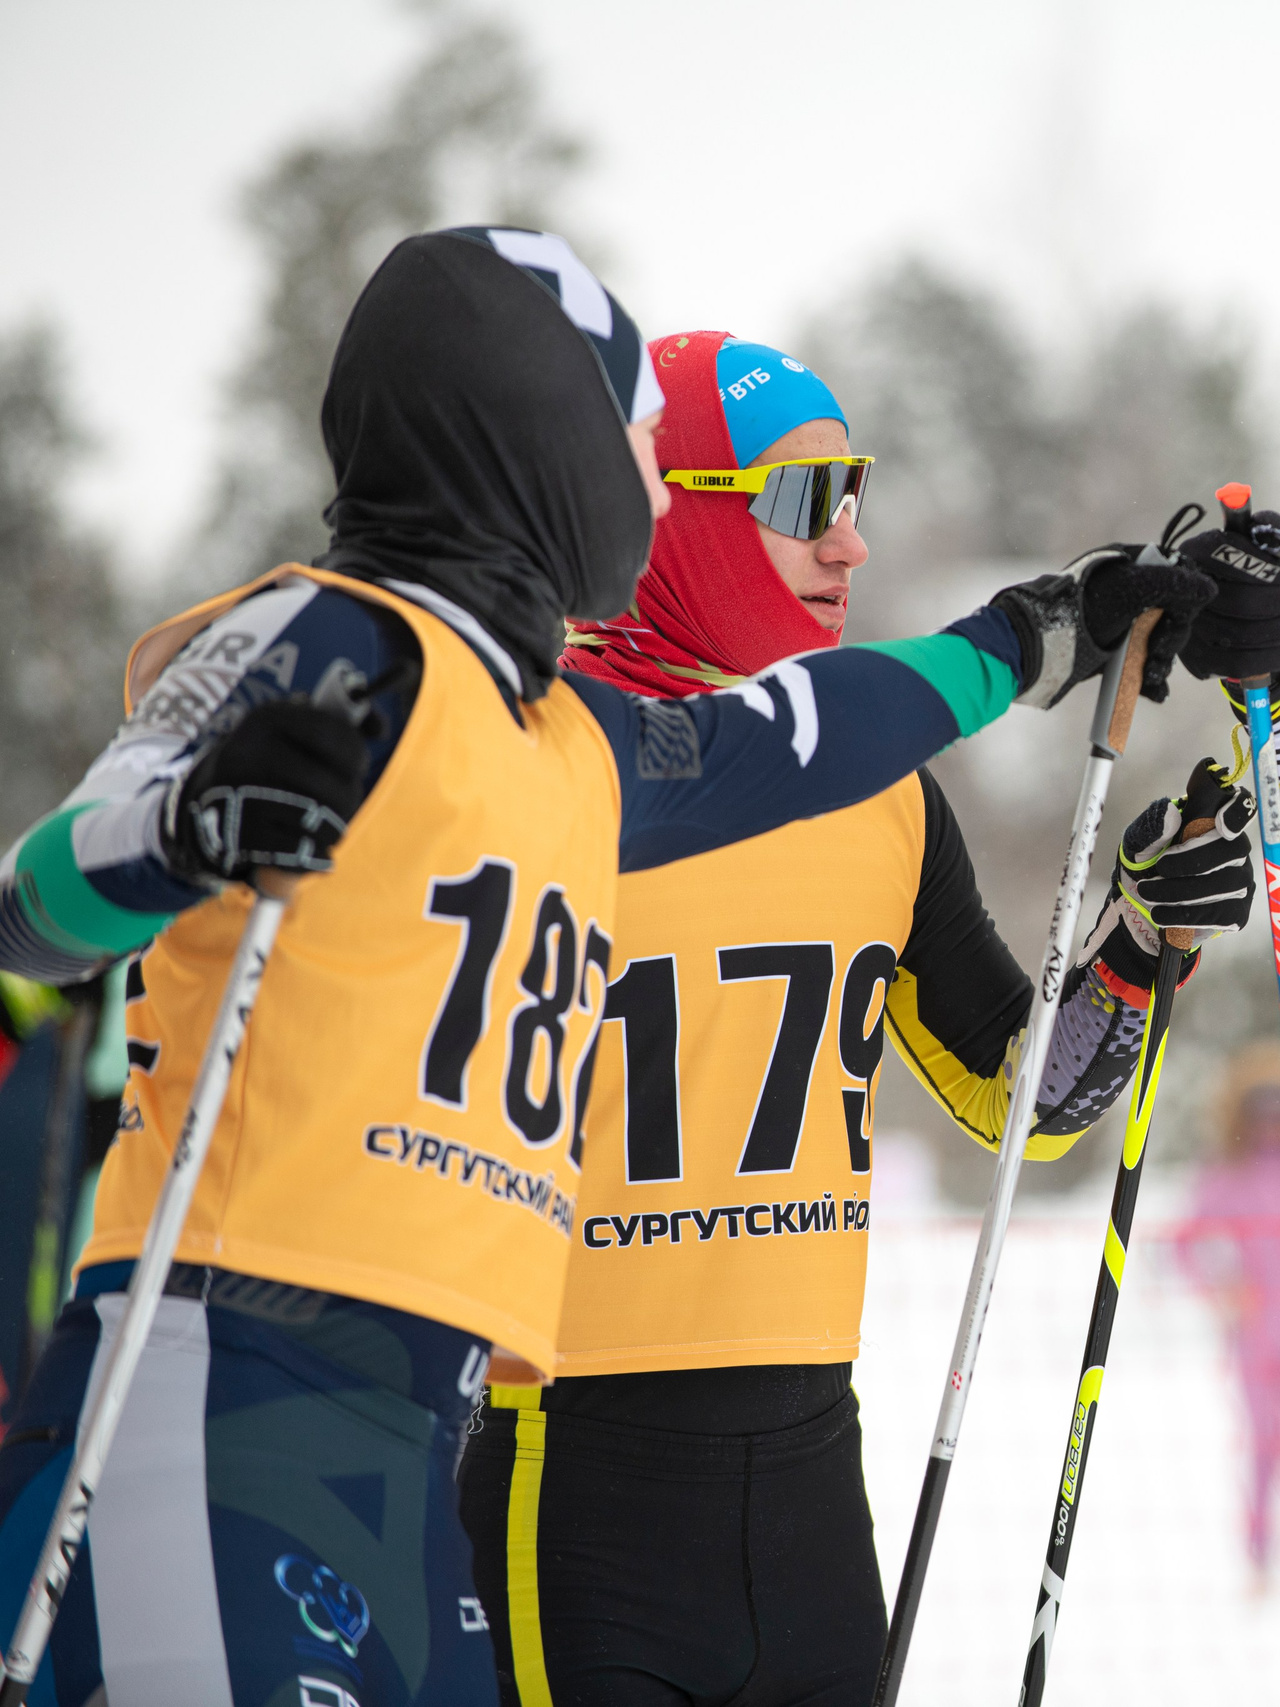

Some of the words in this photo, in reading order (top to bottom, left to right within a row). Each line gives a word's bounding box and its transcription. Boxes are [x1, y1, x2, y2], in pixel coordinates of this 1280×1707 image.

[727, 367, 771, 401] ВТБ
[707, 476, 735, 487] BLIZ
[602, 940, 898, 1186] 179
[583, 1191, 838, 1248] СУРГУТСКИЙ
[1054, 1499, 1071, 1546] 100%
